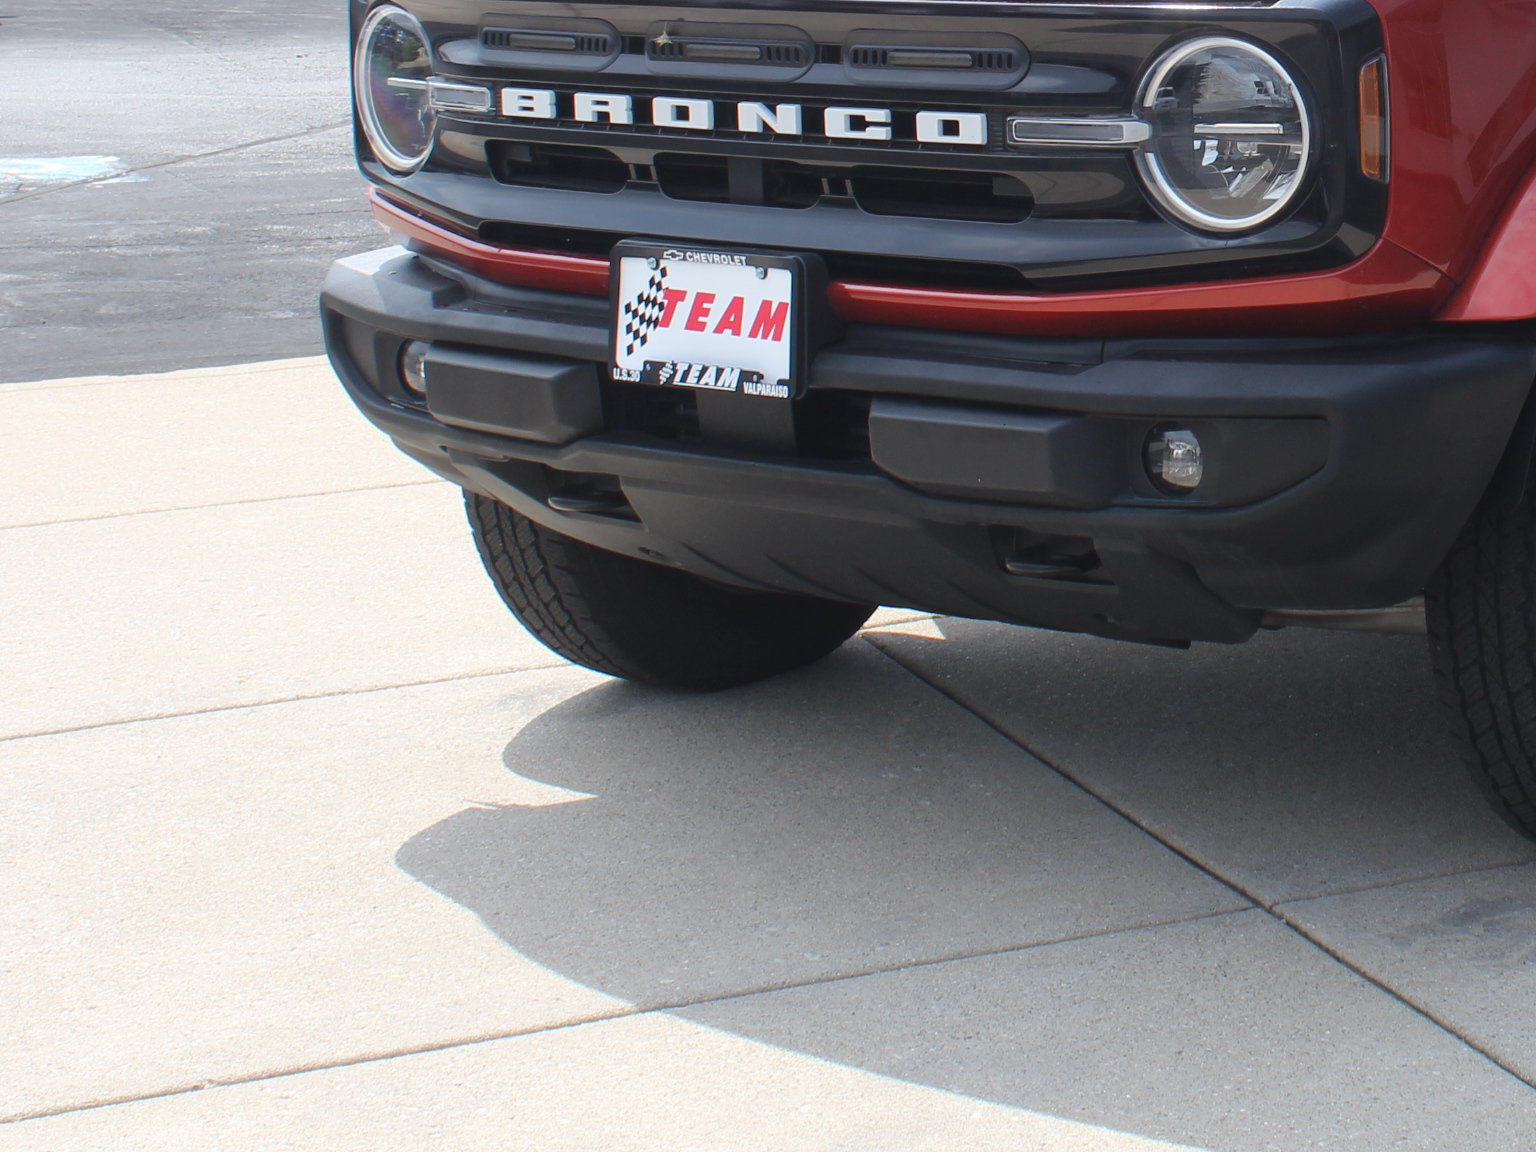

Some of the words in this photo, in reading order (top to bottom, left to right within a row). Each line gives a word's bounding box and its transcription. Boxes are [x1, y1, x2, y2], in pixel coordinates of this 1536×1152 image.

[501, 86, 987, 145] BRONCO
[686, 251, 747, 266] CHEVROLET
[658, 288, 789, 342] TEAM
[672, 362, 742, 389] TEAM
[743, 381, 788, 398] VALPARAISO
